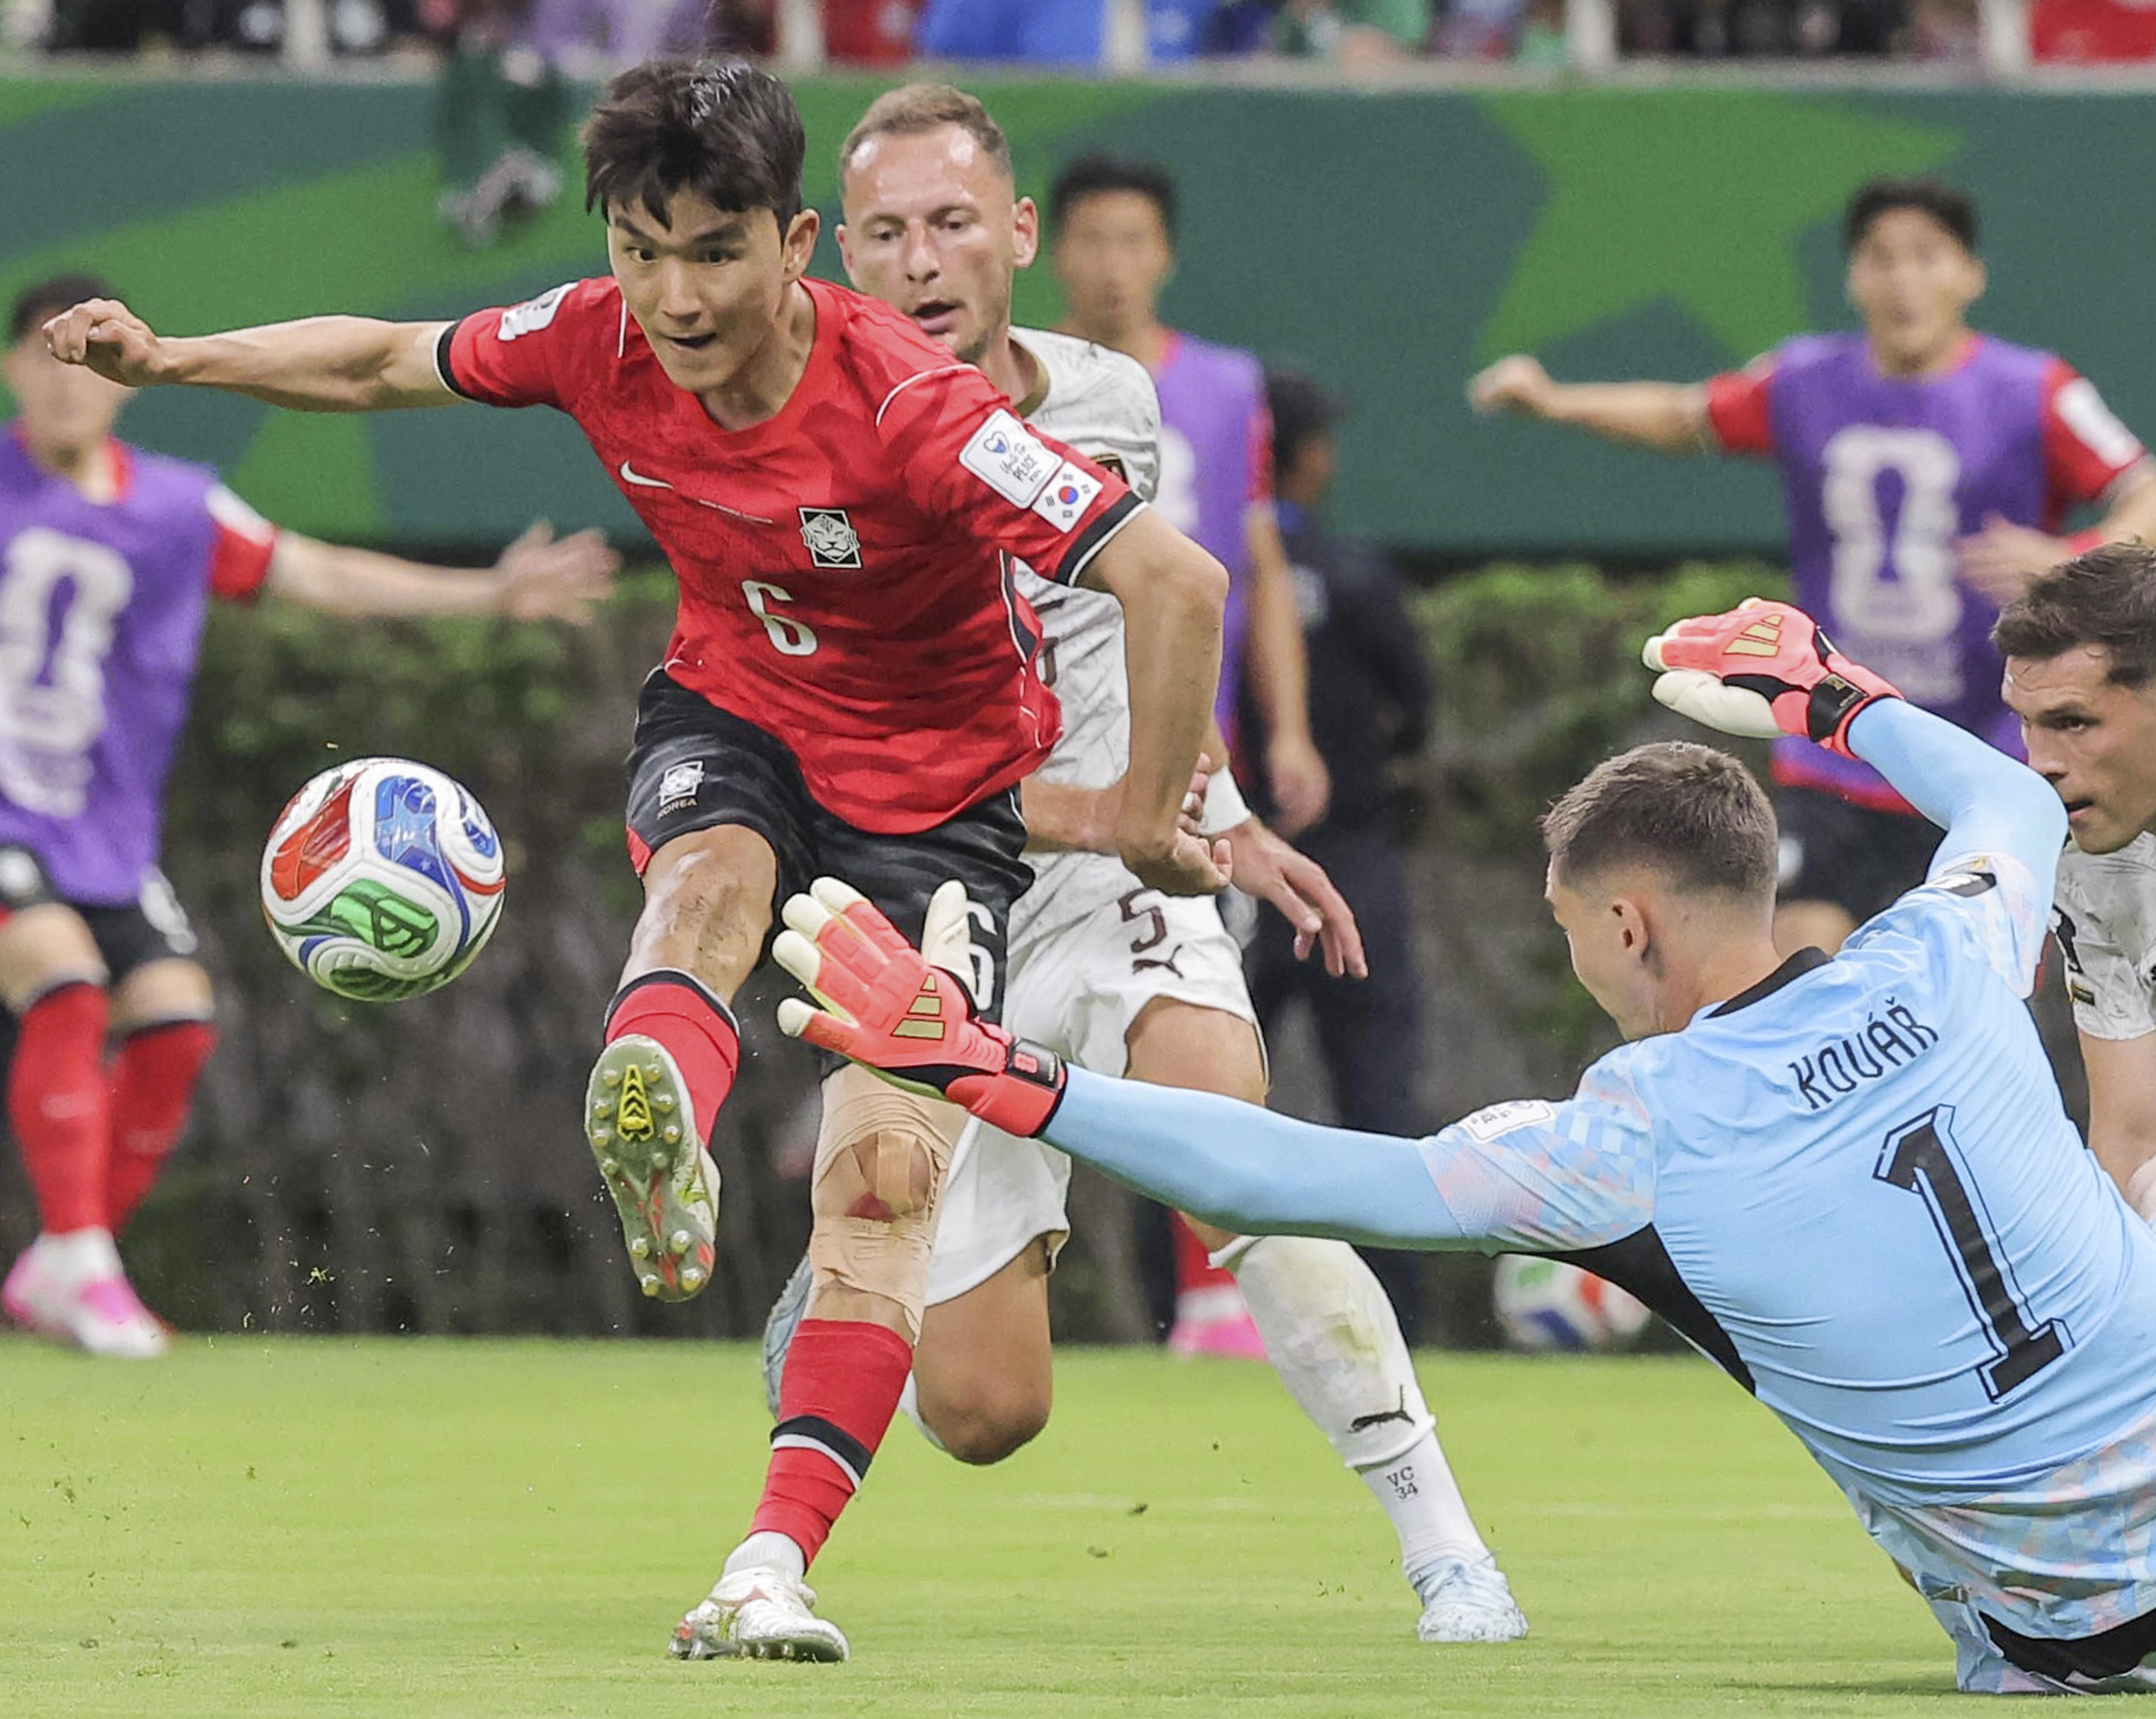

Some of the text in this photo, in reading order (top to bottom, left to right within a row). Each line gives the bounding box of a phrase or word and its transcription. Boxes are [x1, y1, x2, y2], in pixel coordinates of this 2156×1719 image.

[741, 579, 818, 656] 6
[657, 798, 698, 820] KOREA
[1117, 886, 1167, 953] 5
[1872, 1103, 2076, 1404] 1
[1385, 1466, 1414, 1487] VC
[1394, 1482, 1419, 1500] 34
